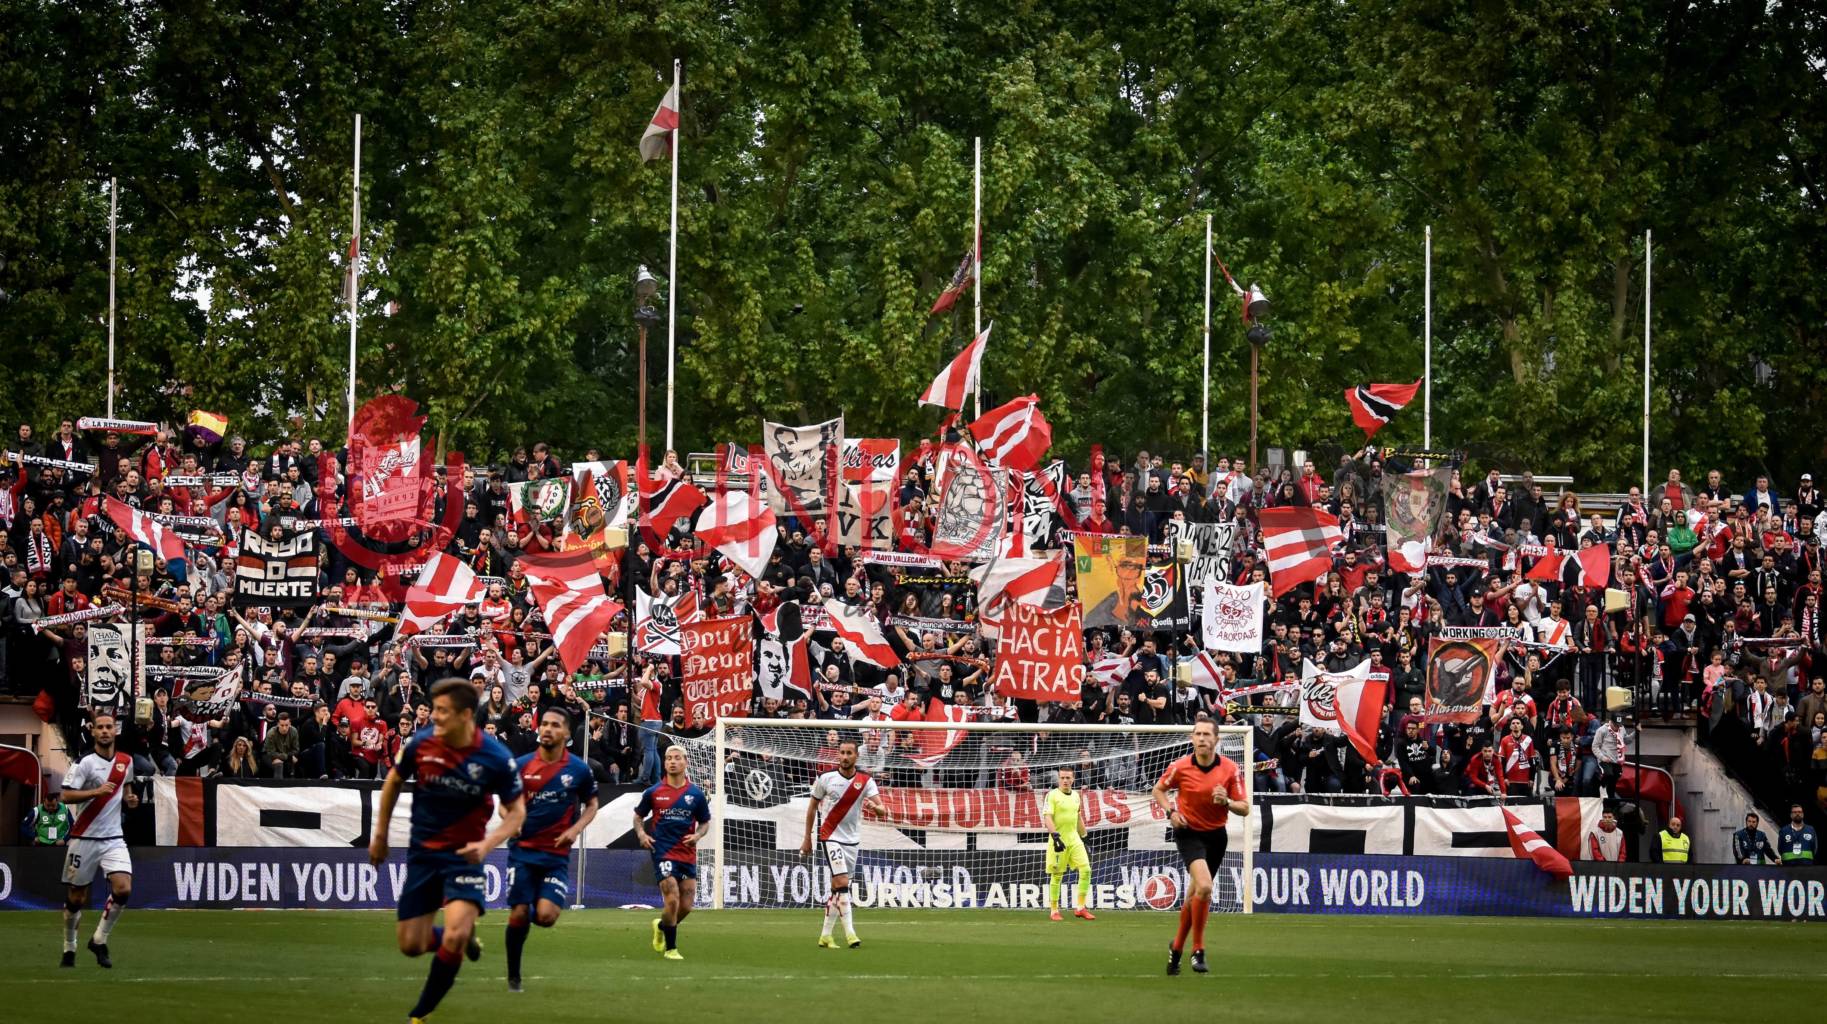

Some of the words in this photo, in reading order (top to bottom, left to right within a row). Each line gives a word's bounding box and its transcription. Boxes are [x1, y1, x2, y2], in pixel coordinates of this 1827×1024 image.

[243, 529, 313, 557] RAYO
[876, 554, 892, 562] RAYO
[892, 556, 928, 565] VALLECANO
[239, 580, 312, 597] MUERTE
[1214, 585, 1251, 600] RAYO
[1216, 628, 1258, 641] ABORDAJE
[1442, 628, 1485, 638] WORKING
[996, 660, 1087, 695] ATRAS
[69, 853, 81, 869] 15
[829, 849, 843, 861] 23
[659, 861, 672, 872] 19
[174, 862, 280, 901] WIDEN
[292, 862, 378, 902] YOUR
[770, 865, 832, 904] YOU
[1319, 868, 1425, 907] WORLD
[852, 883, 977, 907] URKISH
[1569, 875, 1663, 914] WIDEN
[1673, 878, 1750, 916] YOUR
[1758, 879, 1825, 917] WOR
